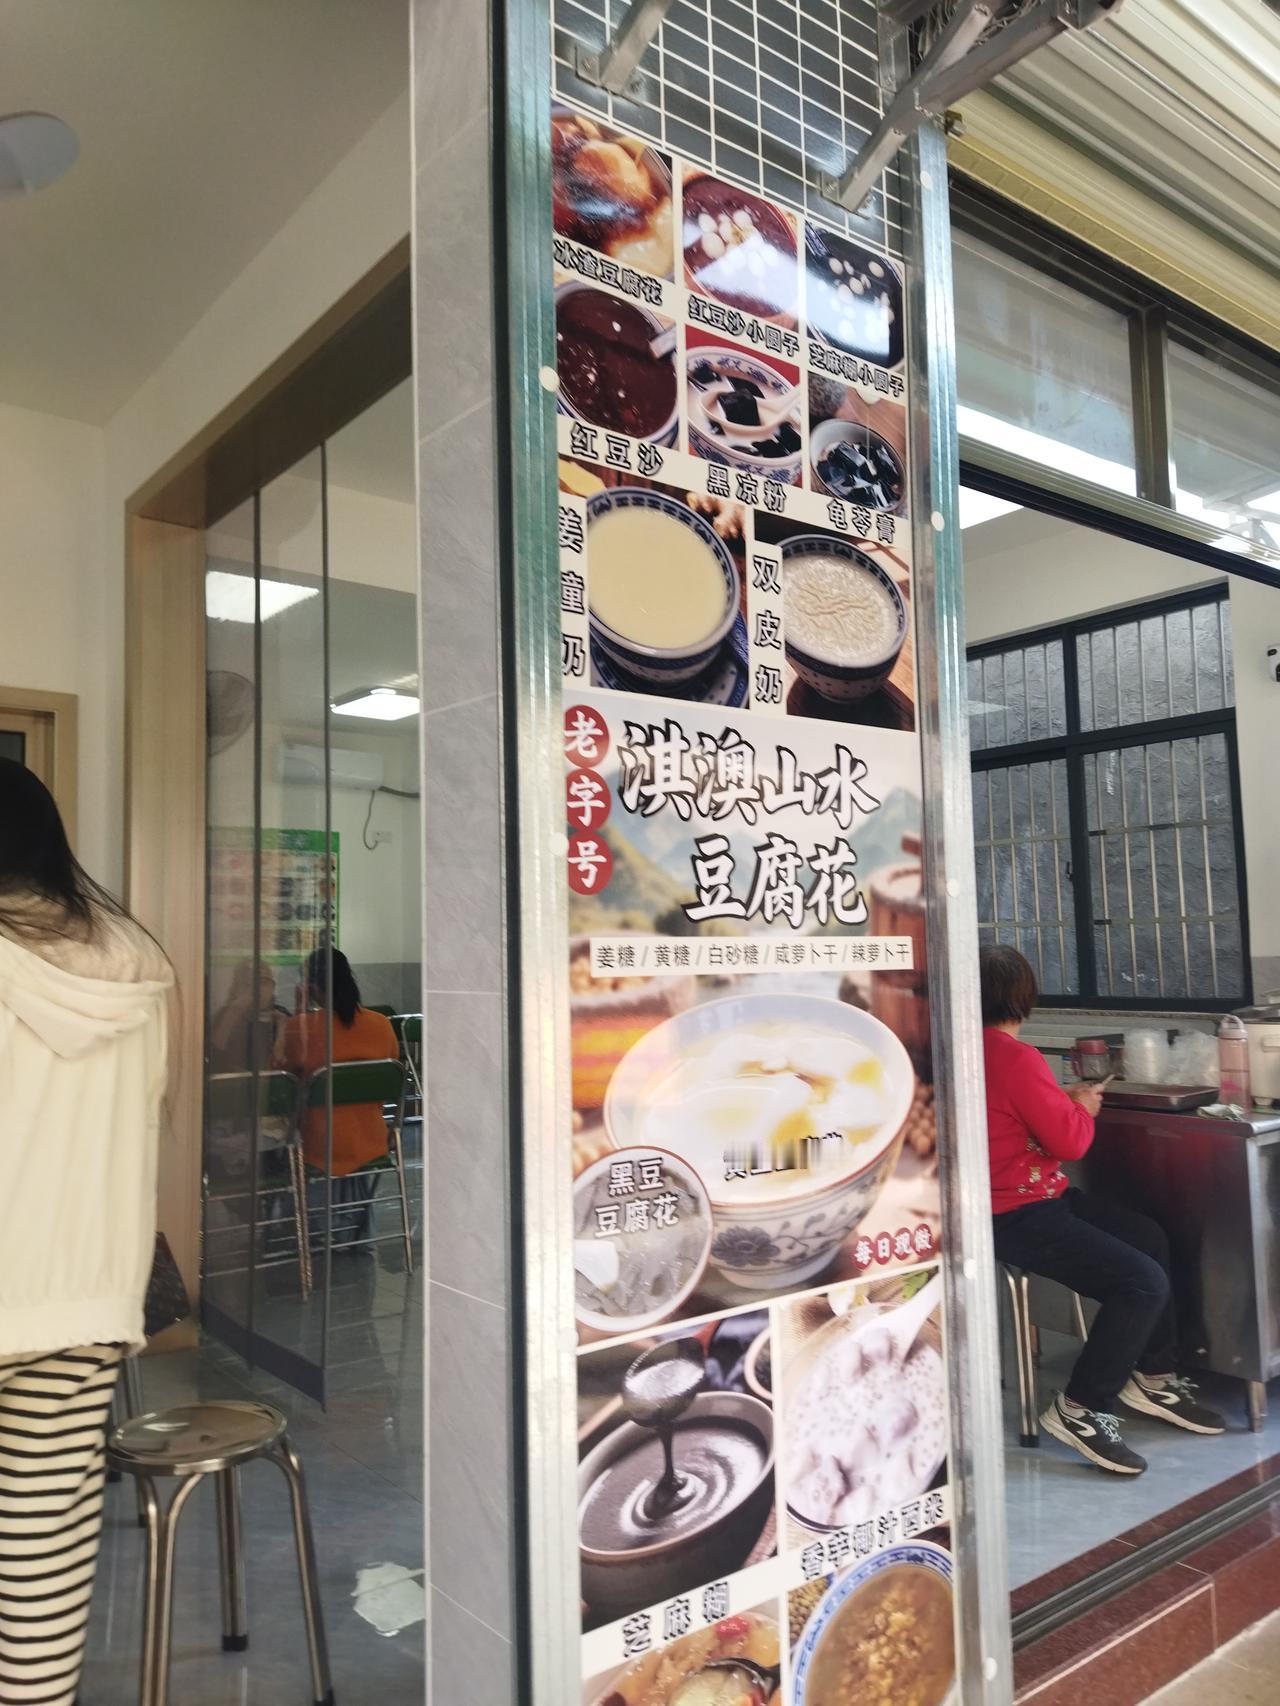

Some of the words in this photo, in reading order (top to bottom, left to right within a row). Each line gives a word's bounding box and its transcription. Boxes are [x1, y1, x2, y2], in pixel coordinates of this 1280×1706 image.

[687, 294, 800, 357] 红豆沙小圆子
[808, 342, 904, 398] 芝麻糊小圆子
[571, 422, 664, 477] 红豆沙
[707, 463, 786, 512] 黑凉粉
[827, 500, 896, 544] 龟苓膏
[753, 555, 782, 704] 双皮奶
[563, 710, 607, 889] 老字号
[617, 718, 881, 829] 淇澳山水
[681, 832, 869, 928] 豆腐花
[608, 1157, 664, 1197] 黑豆
[594, 1192, 680, 1239] 豆腐花
